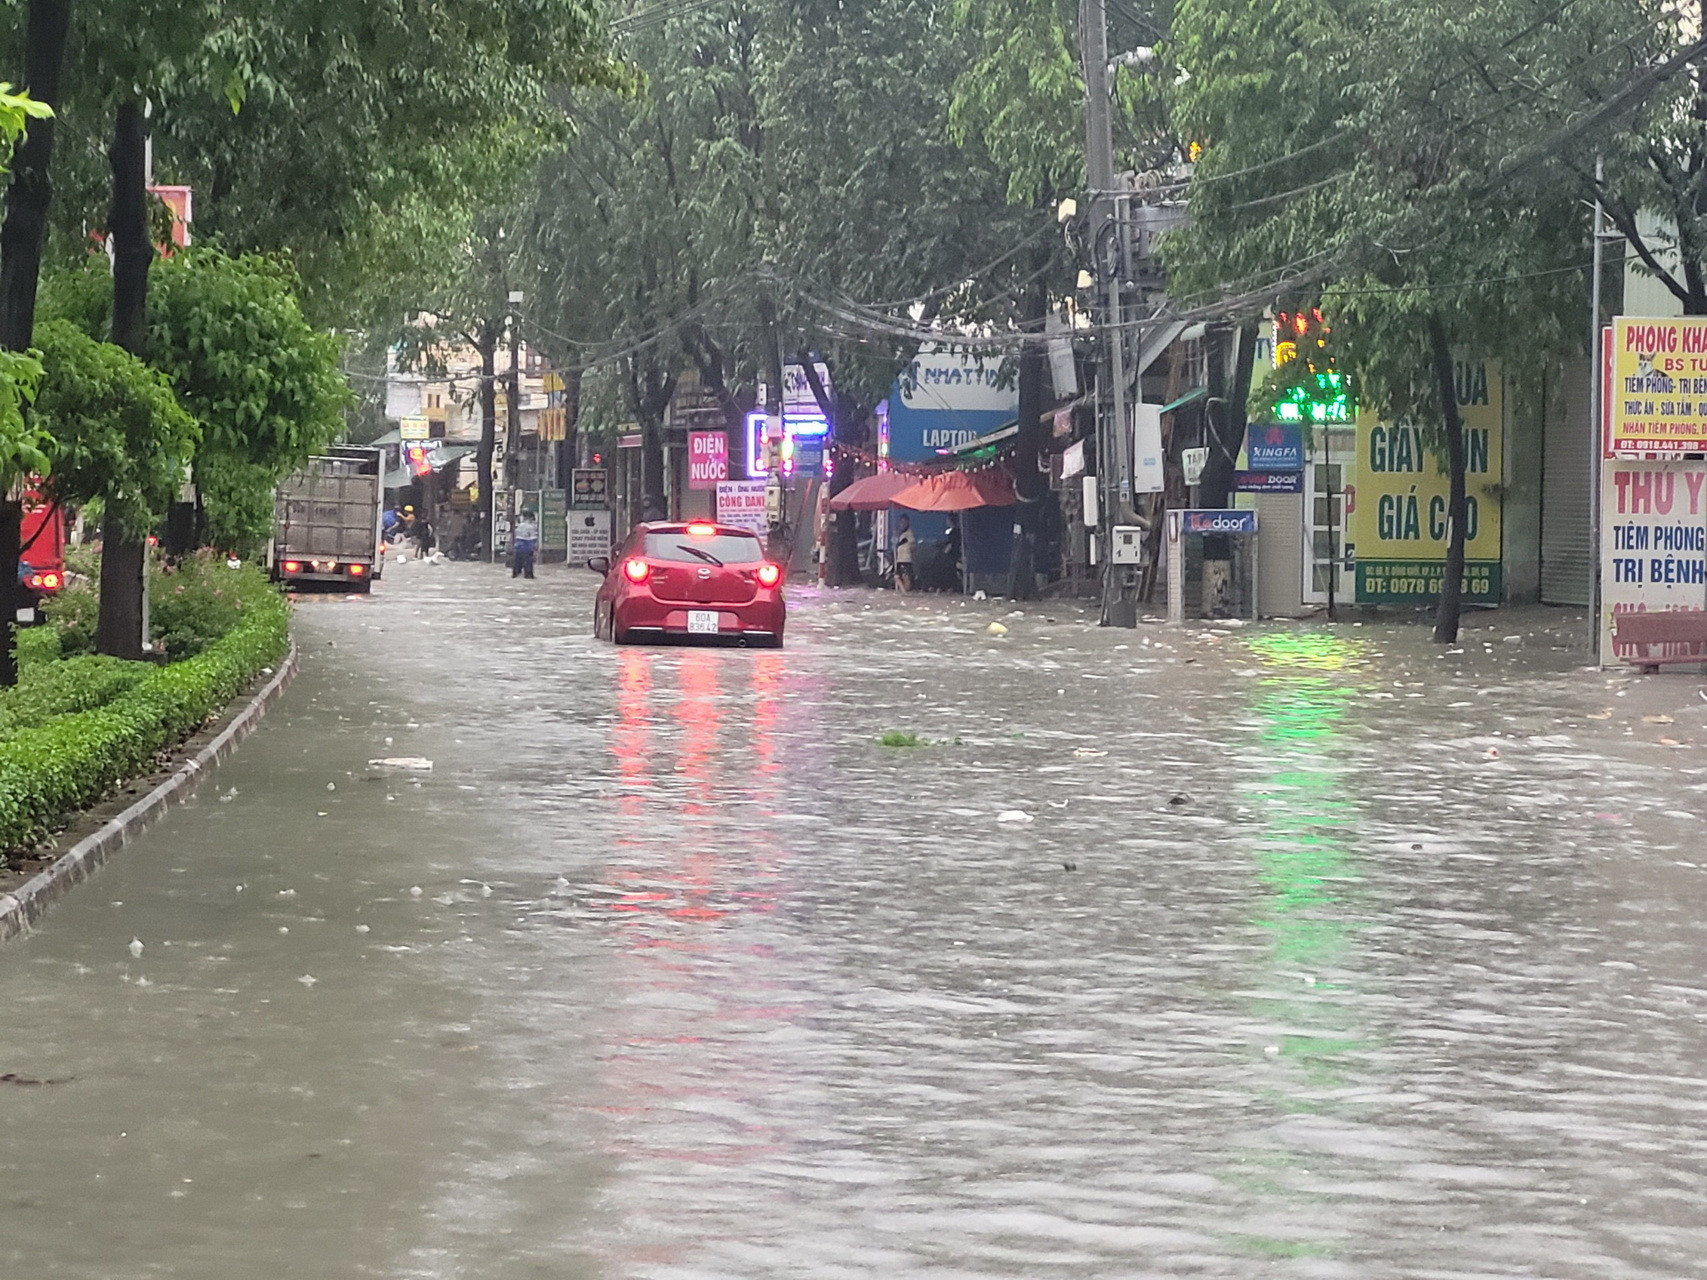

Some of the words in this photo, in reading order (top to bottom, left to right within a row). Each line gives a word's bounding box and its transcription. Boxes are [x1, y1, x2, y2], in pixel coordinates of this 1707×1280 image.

[1664, 358, 1684, 371] BS
[693, 433, 724, 459] ĐIỆN
[691, 457, 726, 480] NƯỚC
[1614, 464, 1675, 515] THÚ
[1684, 471, 1705, 514] Y
[1378, 484, 1420, 541] GIÁ
[1429, 494, 1478, 541] CO
[1613, 520, 1649, 550] TIÊM
[1654, 519, 1705, 552] PHÒNG
[1612, 558, 1644, 589] TRỊ
[1650, 553, 1705, 589] BỆNH
[1390, 578, 1425, 594] 0978
